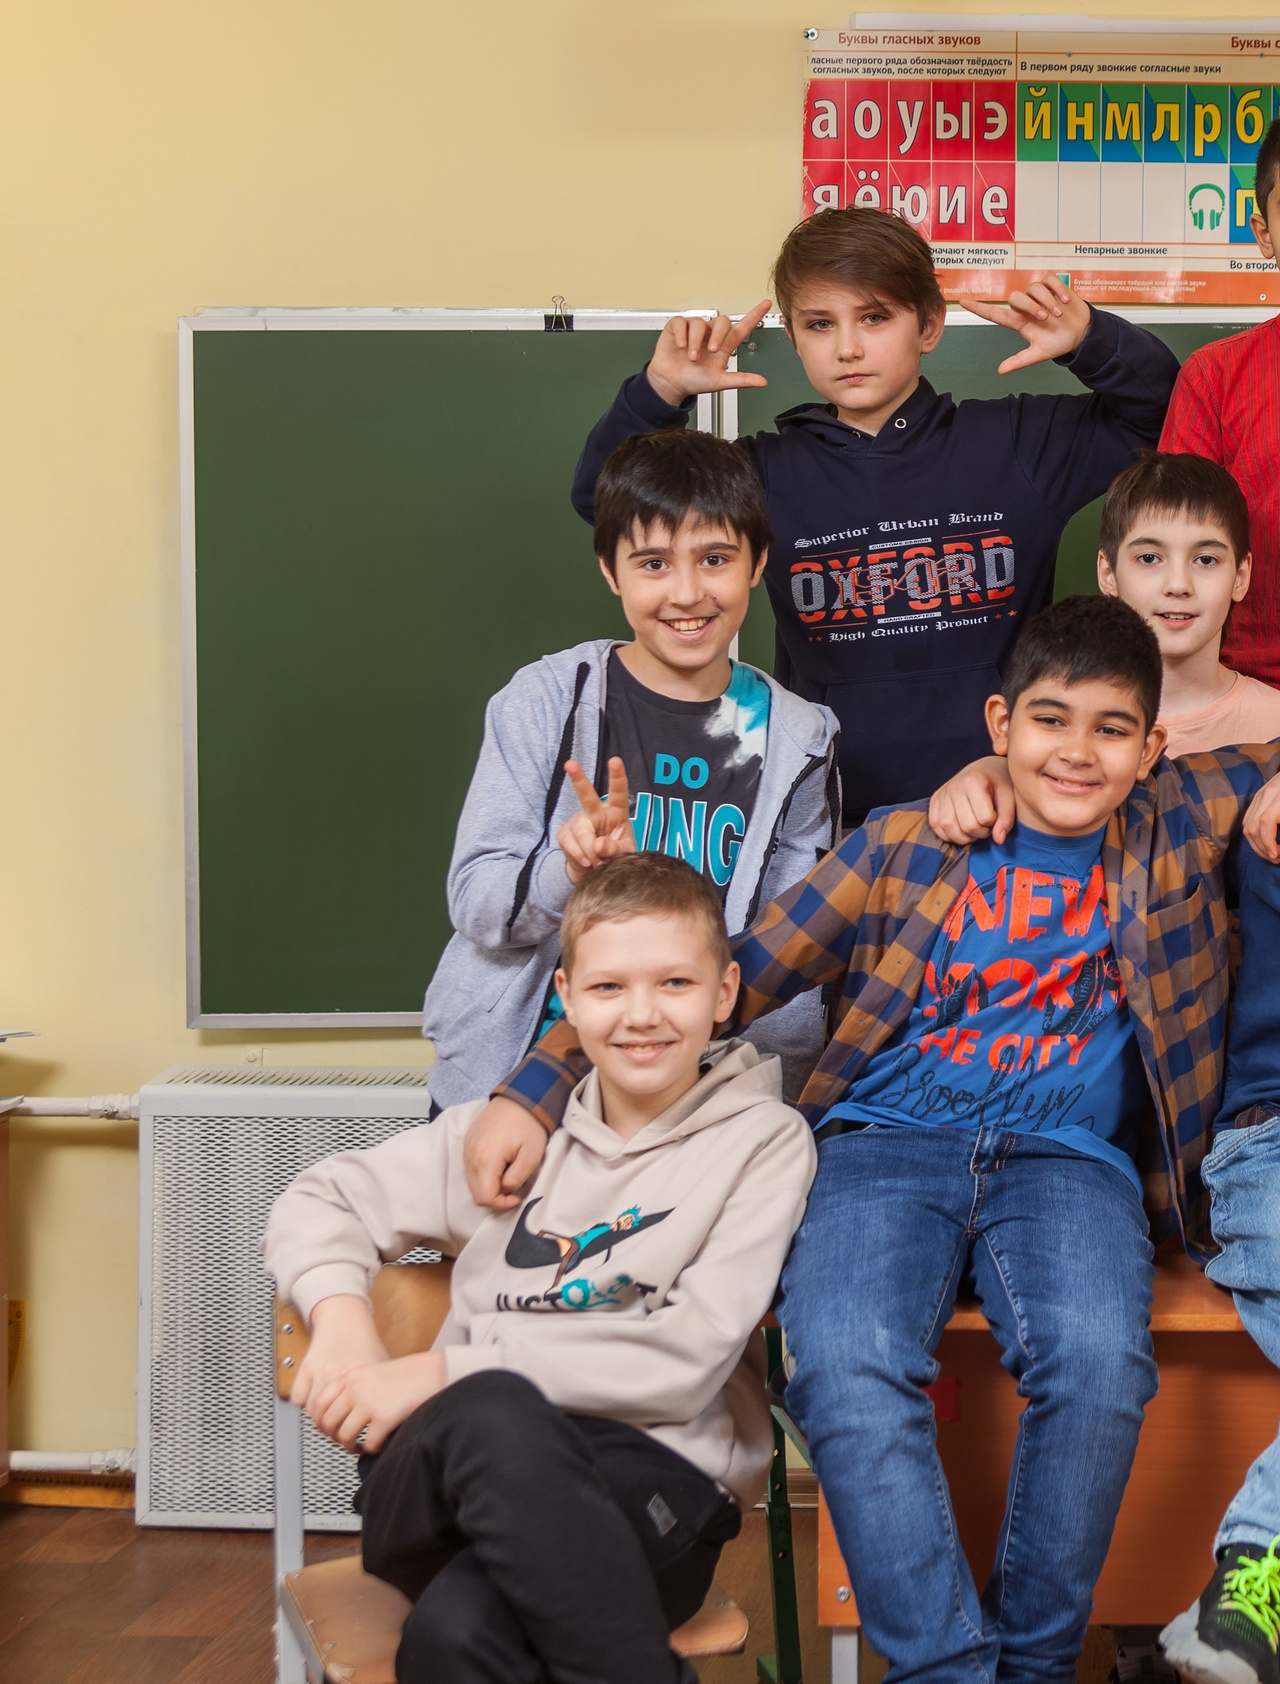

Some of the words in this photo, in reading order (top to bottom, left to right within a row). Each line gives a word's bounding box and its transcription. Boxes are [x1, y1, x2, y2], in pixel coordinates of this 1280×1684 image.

[838, 32, 878, 46] Буквы
[882, 34, 934, 45] гласных
[938, 35, 981, 47] звуков
[1231, 36, 1271, 51] Буквы
[807, 56, 844, 65] ласные
[846, 57, 883, 67] первого
[885, 58, 907, 67] ряда
[910, 57, 965, 66] обозначают
[967, 57, 1013, 67] твёрдость
[1021, 62, 1027, 71] В
[1030, 64, 1067, 73] первом
[1070, 64, 1094, 73] ряду
[1097, 64, 1137, 72] звонкие
[1139, 64, 1190, 73] согласные
[1193, 65, 1221, 74] звуки
[813, 66, 859, 75] согласных
[862, 66, 895, 76] звуков,
[898, 67, 924, 75] после
[927, 67, 965, 76] которых
[968, 68, 1006, 76] следуют
[932, 247, 965, 256] начают
[967, 247, 1009, 256] мягкость
[1074, 245, 1125, 256] Непарные
[1127, 246, 1168, 255] звонкие
[932, 256, 964, 266] оторых
[966, 257, 1005, 267] следуют
[1230, 259, 1243, 269] Во
[794, 527, 870, 548] Superior
[877, 518, 939, 532] Urban
[948, 511, 1003, 525] Brand
[790, 535, 1015, 623] OXFORD
[829, 631, 866, 642] High
[872, 625, 928, 637] Quality
[935, 616, 988, 631] Product
[654, 752, 709, 789] DO
[988, 1033, 1094, 1074] CITY
